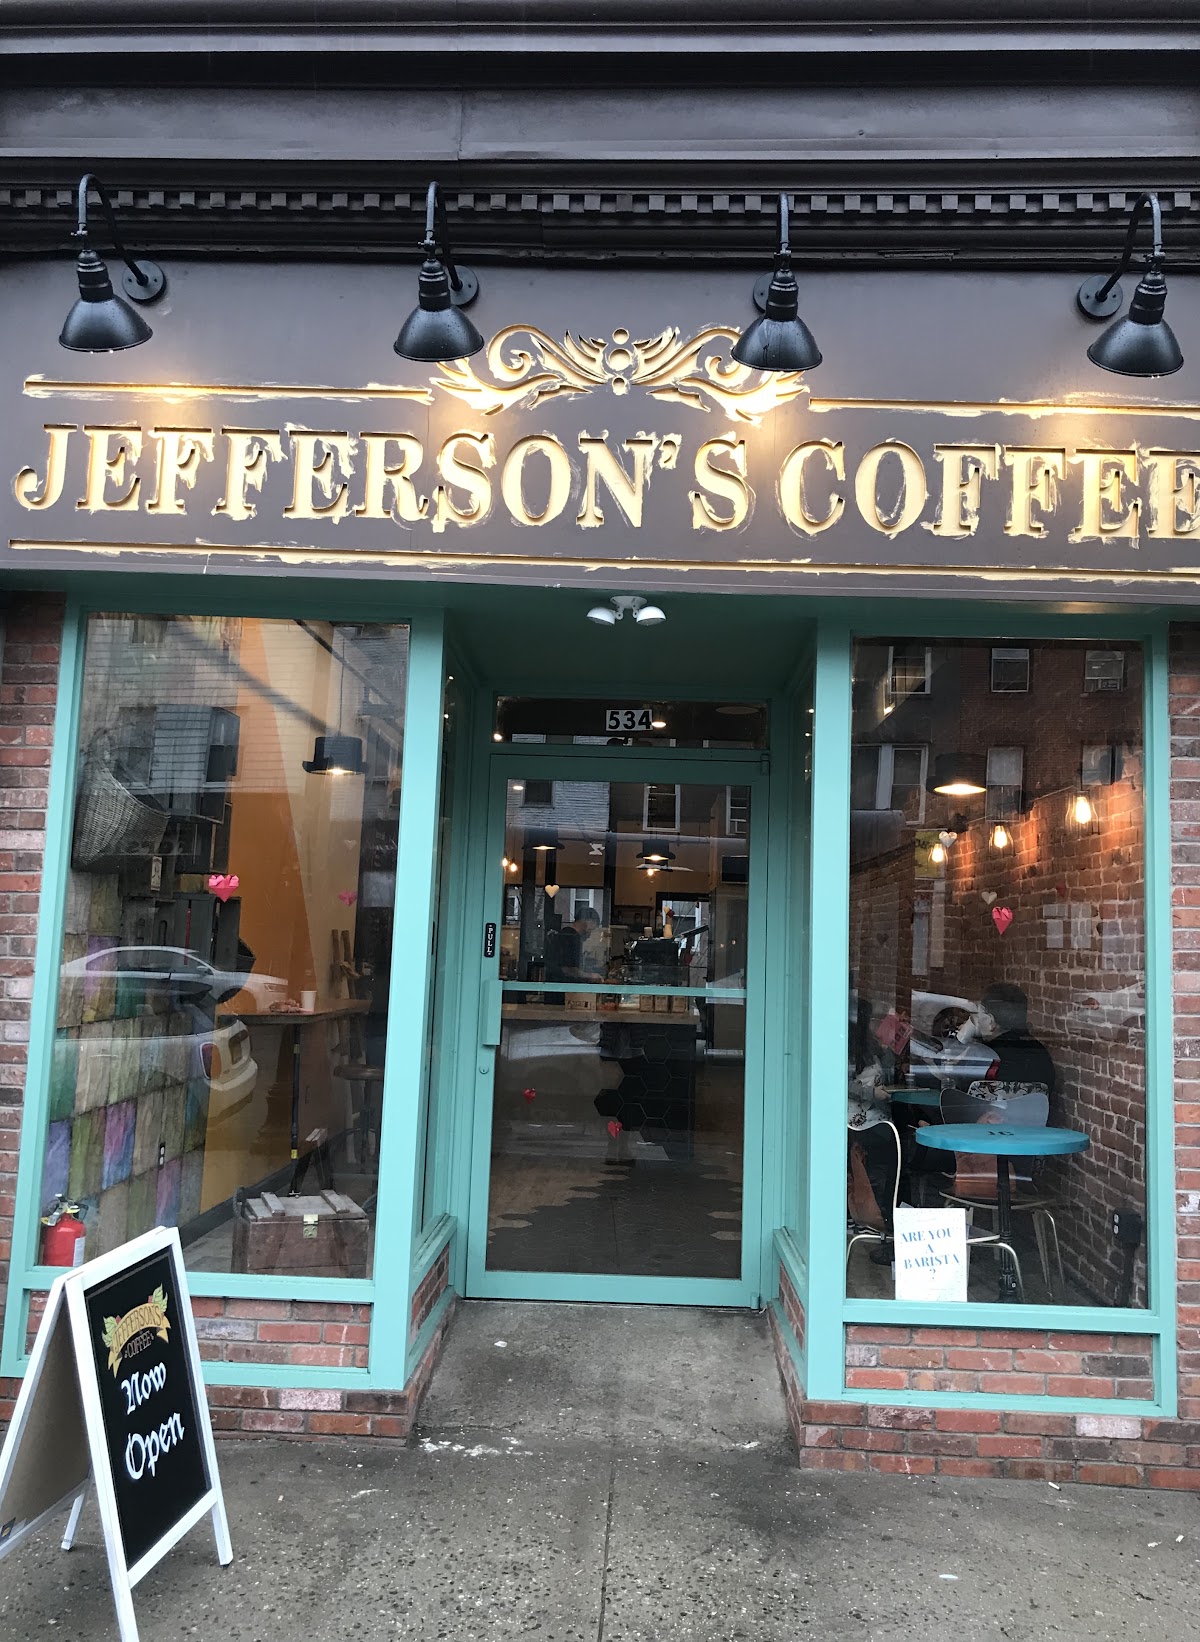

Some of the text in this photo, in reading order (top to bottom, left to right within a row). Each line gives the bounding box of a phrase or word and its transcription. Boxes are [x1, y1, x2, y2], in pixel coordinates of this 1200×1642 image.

[12, 420, 1200, 544] JEFFERSON'S COFFEE
[607, 710, 652, 730] 534
[486, 927, 494, 953] PULL
[899, 1227, 955, 1244] ARE YOU
[925, 1243, 935, 1254] A
[903, 1253, 961, 1270] BARISTA
[127, 1330, 152, 1359] COFFEE
[120, 1361, 167, 1416] Now
[124, 1412, 186, 1481] Open
